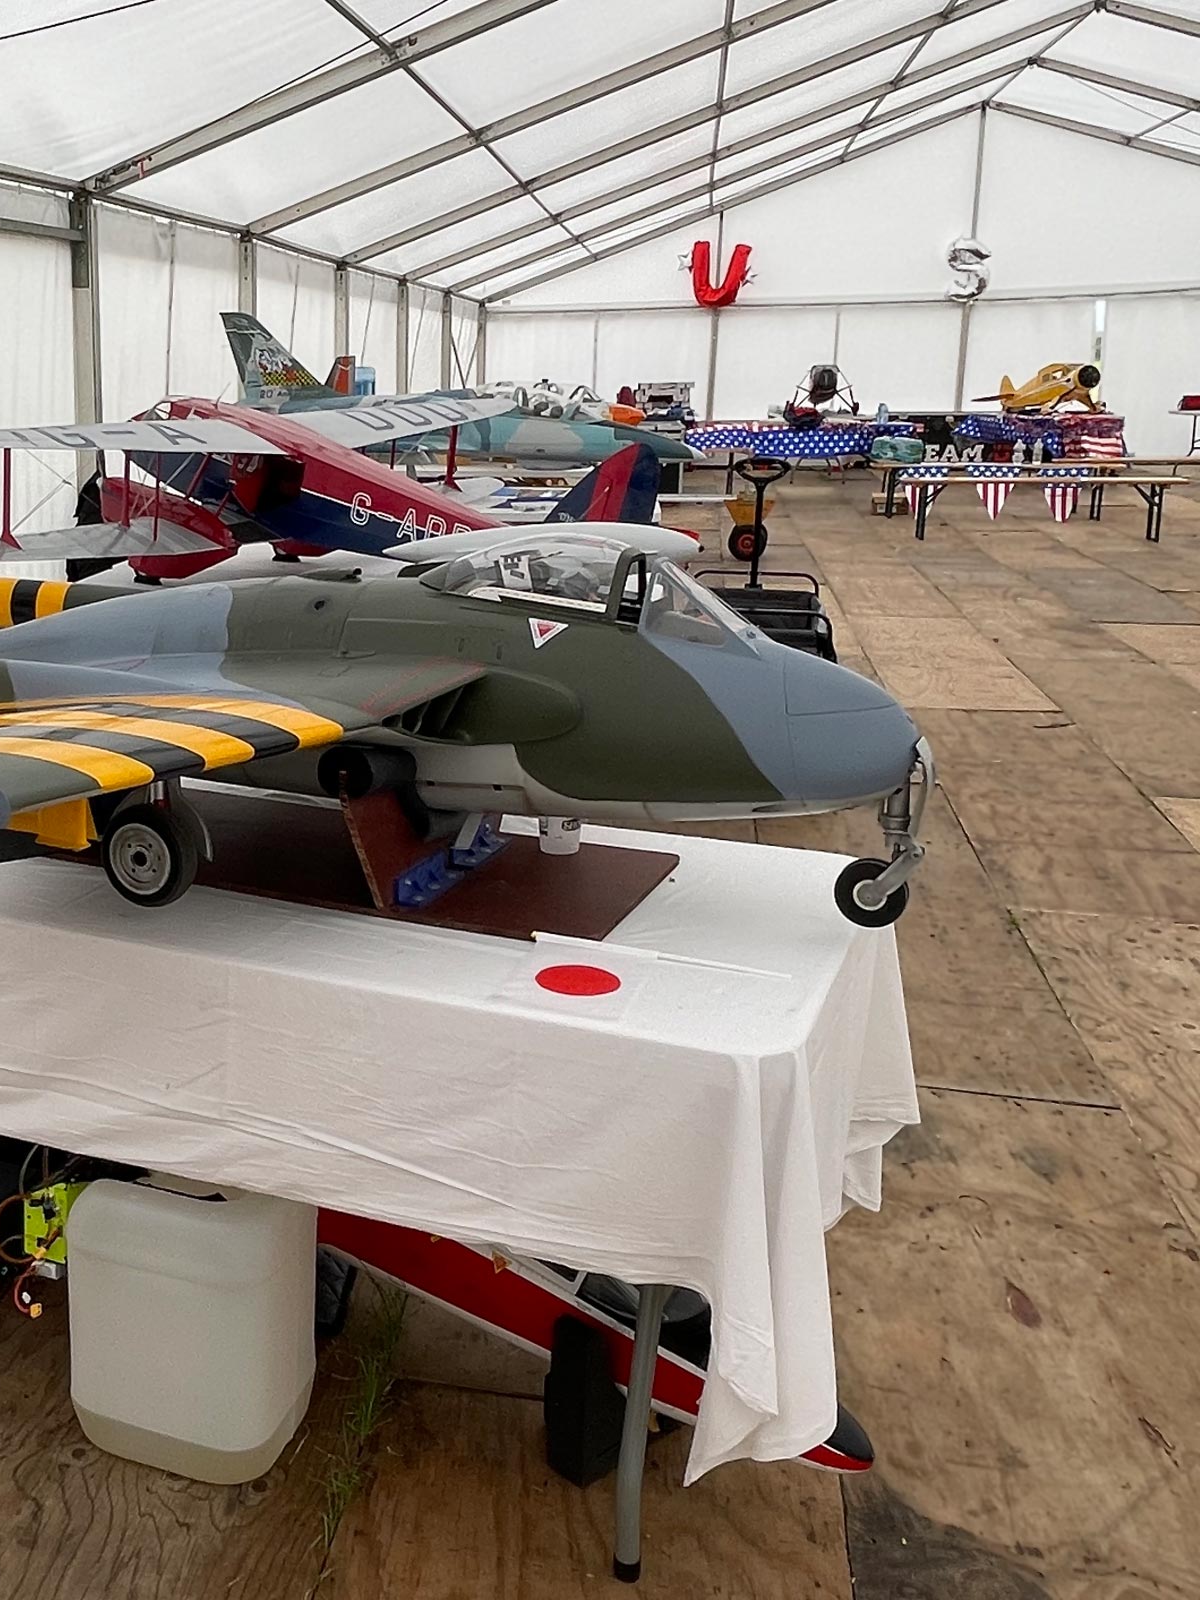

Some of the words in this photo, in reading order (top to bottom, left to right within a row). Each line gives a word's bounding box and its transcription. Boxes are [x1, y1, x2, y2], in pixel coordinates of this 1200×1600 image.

[692, 241, 752, 307] U
[946, 237, 991, 302] S
[924, 443, 985, 463] EAM
